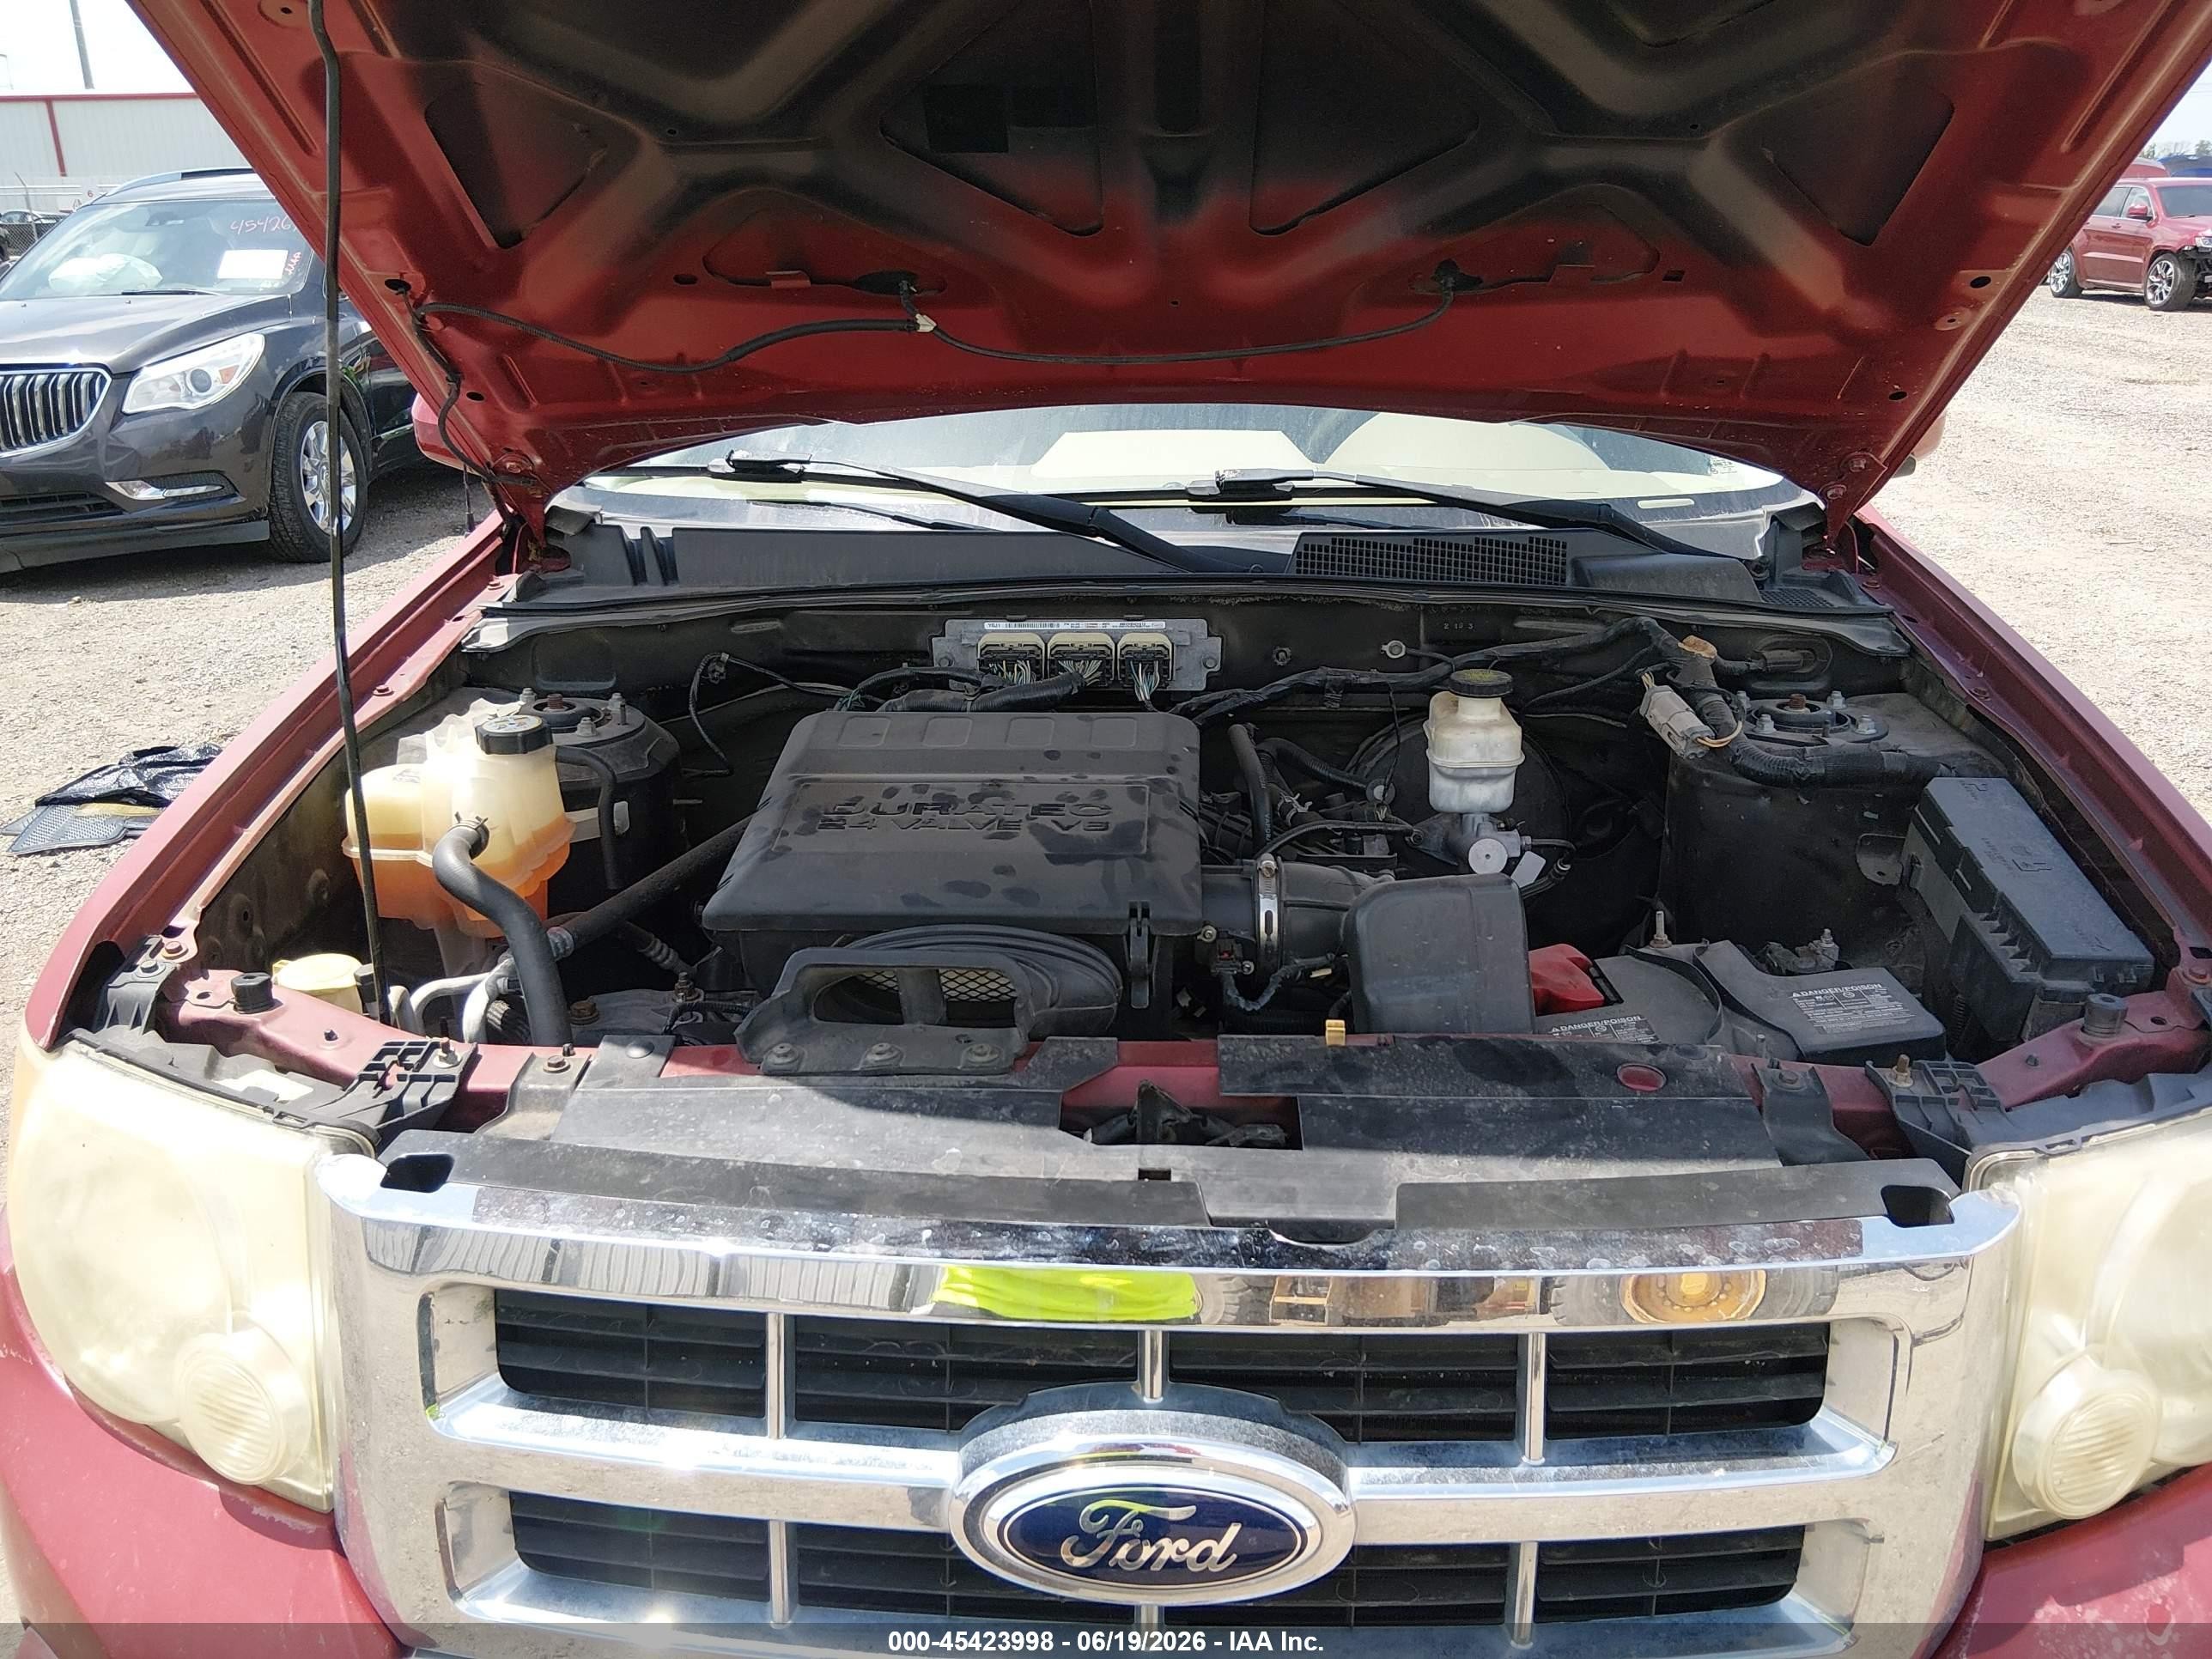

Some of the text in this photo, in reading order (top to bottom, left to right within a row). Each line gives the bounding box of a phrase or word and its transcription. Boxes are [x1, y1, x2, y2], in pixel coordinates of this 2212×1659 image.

[230, 216, 297, 234] 45426
[823, 802, 1112, 817] DURATEC
[817, 817, 878, 831] 24
[891, 817, 1023, 831] VALVE
[1060, 1499, 1242, 1572] Ford
